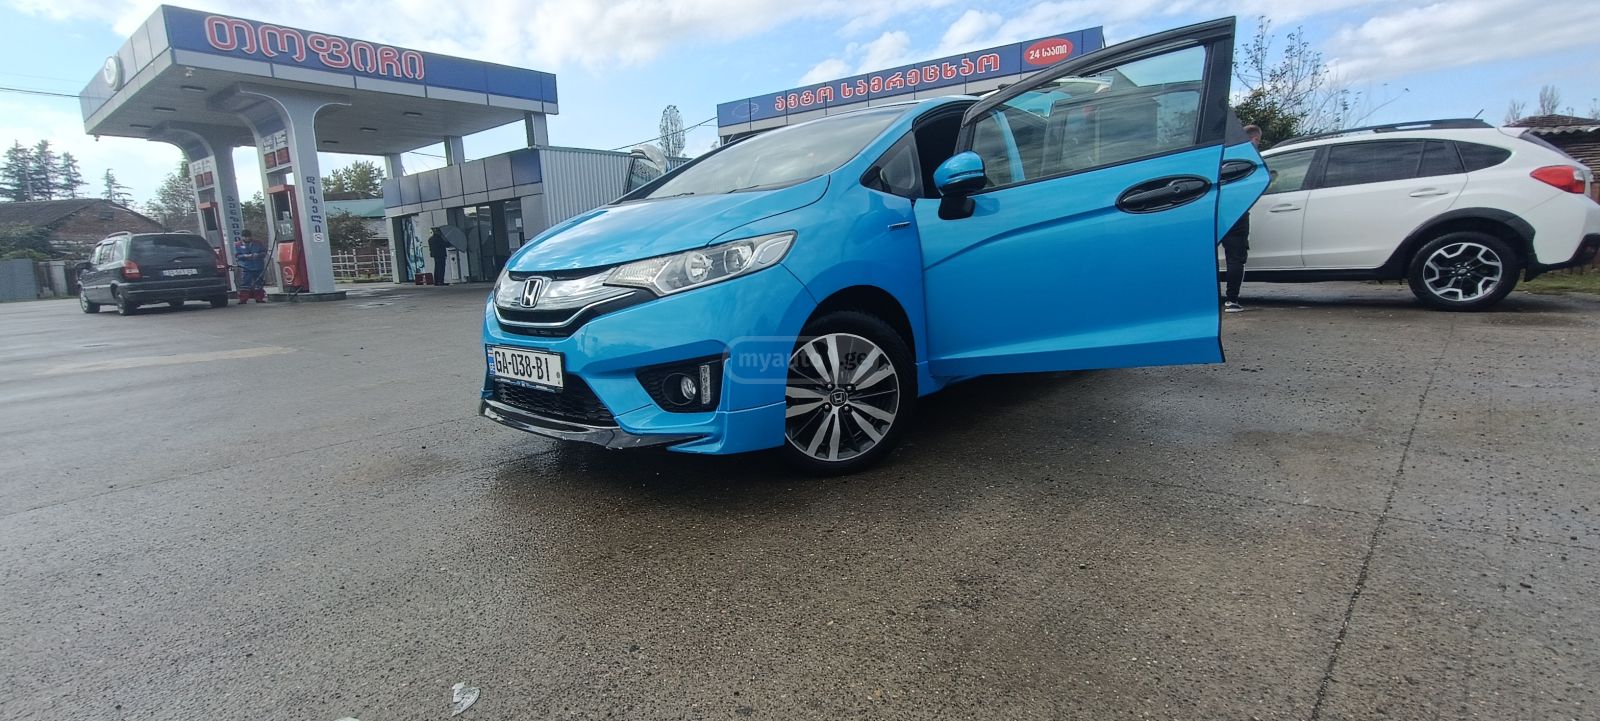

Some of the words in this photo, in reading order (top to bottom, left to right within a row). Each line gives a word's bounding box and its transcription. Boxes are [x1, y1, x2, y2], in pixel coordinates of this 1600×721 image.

[1029, 49, 1041, 60] 24
[1041, 44, 1068, 57] საათი
[774, 85, 834, 112] ავტო
[840, 52, 1001, 99] სამრეცხაო
[306, 176, 322, 234] დიზელი
[494, 350, 550, 382] GA-038-BI
